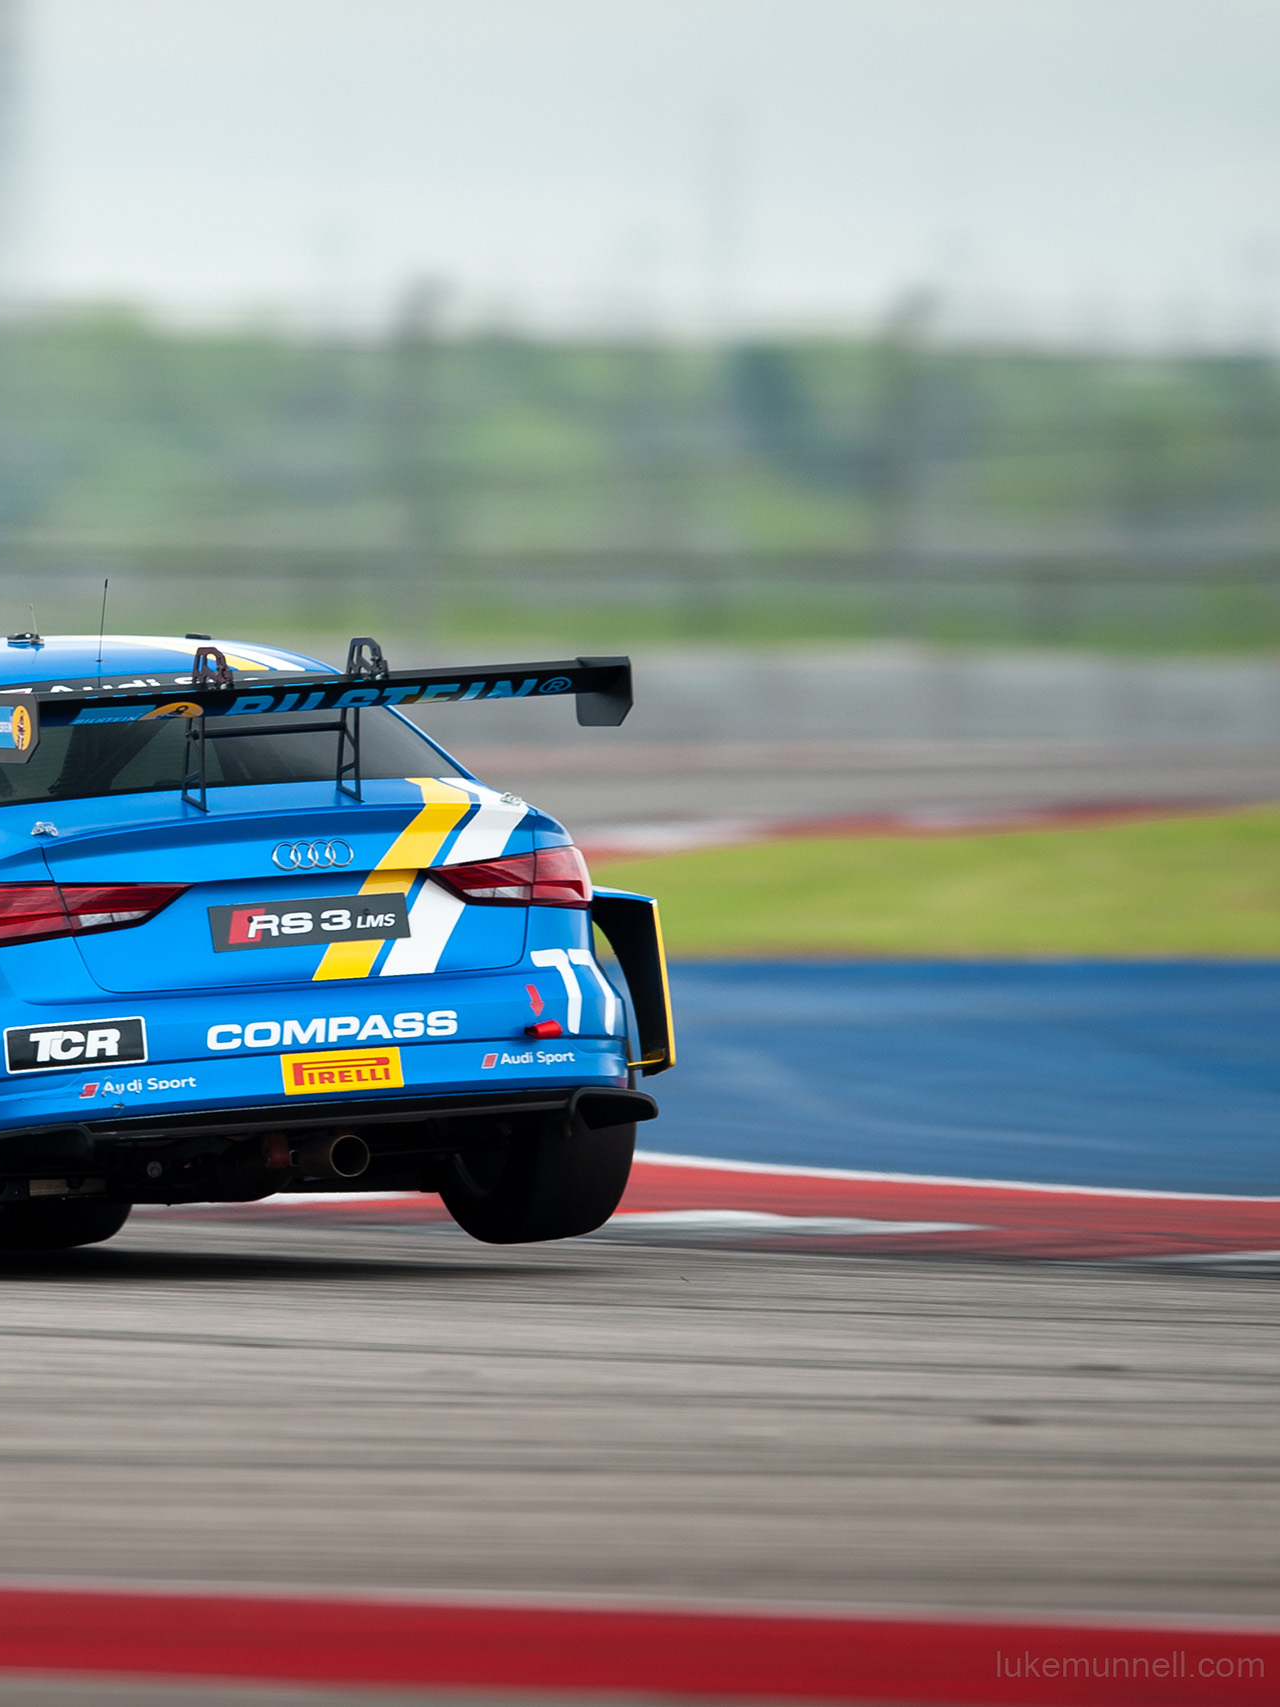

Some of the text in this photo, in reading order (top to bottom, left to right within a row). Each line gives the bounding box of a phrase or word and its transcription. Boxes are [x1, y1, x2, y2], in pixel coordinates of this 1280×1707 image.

[247, 908, 396, 939] RS 3 LMS
[530, 948, 617, 1036] 77
[29, 1028, 121, 1062] TCR
[206, 1010, 458, 1051] COMPASS
[292, 1056, 392, 1087] PIRELLI
[500, 1051, 576, 1065] Audi Sport
[103, 1076, 197, 1093] Audi Sport
